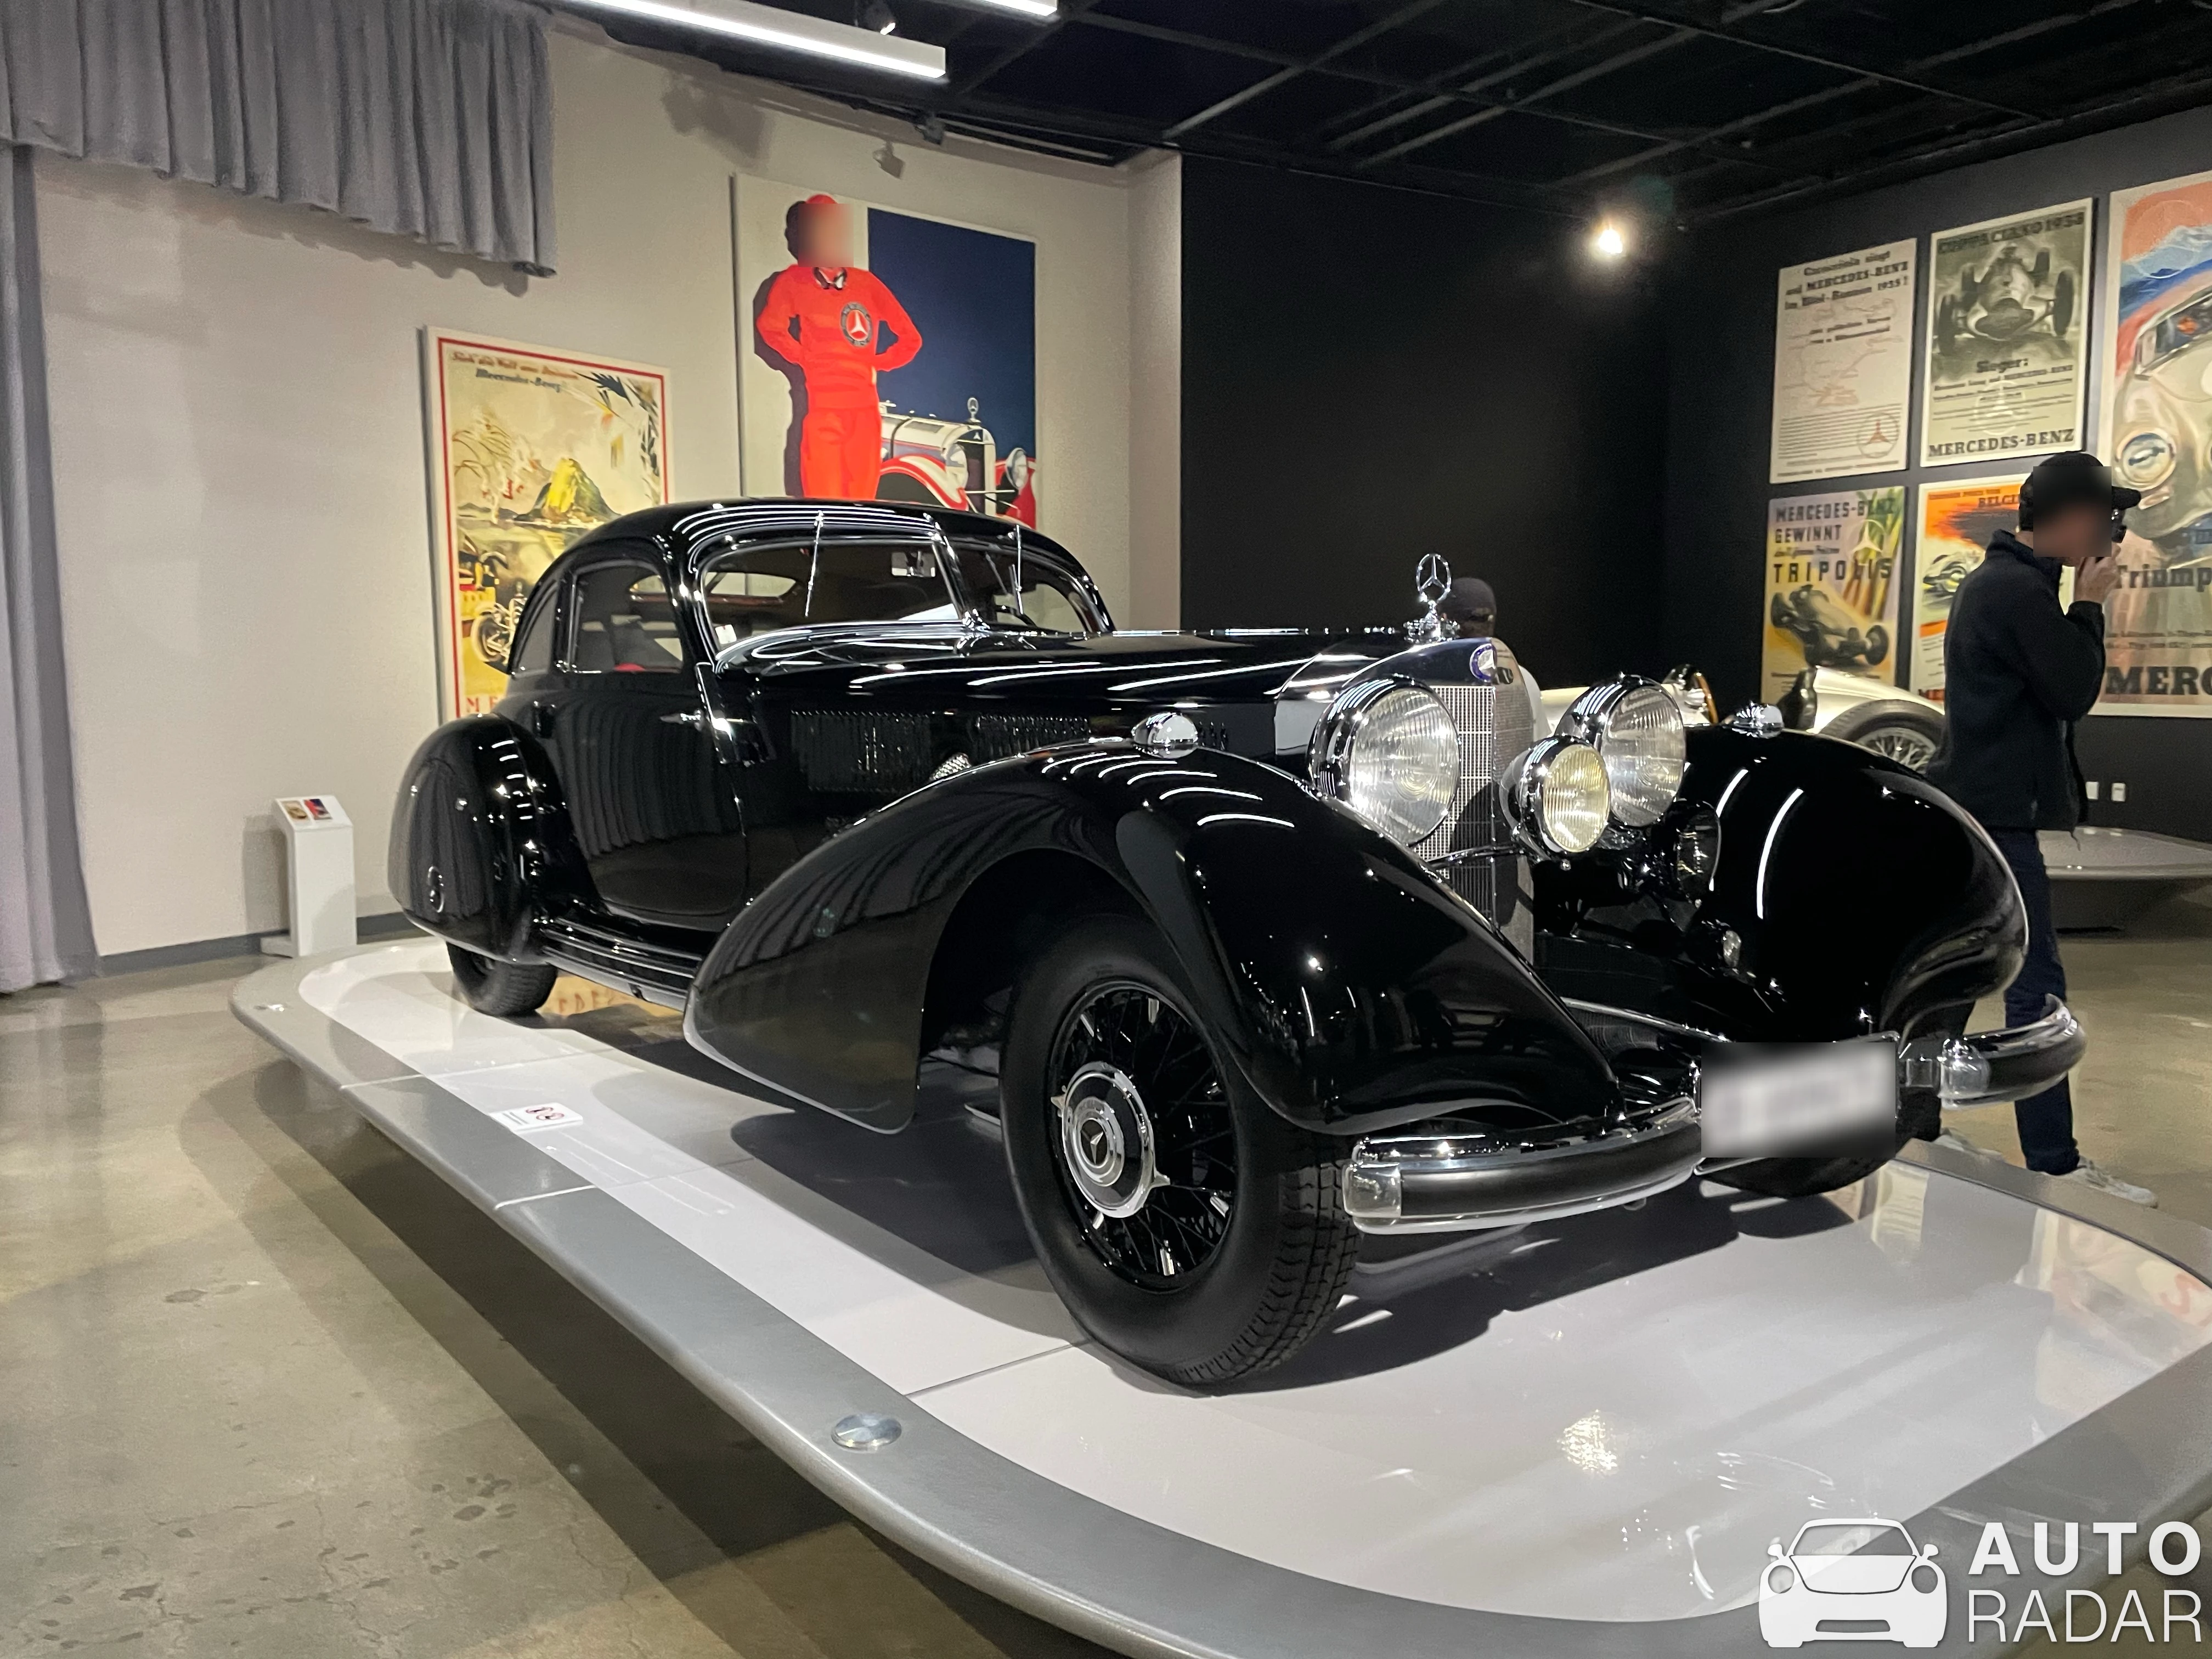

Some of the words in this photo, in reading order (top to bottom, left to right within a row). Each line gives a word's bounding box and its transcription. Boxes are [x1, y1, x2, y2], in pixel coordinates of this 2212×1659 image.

[1928, 428, 2075, 458] MERCEDES-BENZ
[1978, 494, 2021, 507] BELGI
[1775, 524, 1842, 543] GEWINNT
[1774, 558, 1892, 583] TRIPOLIS
